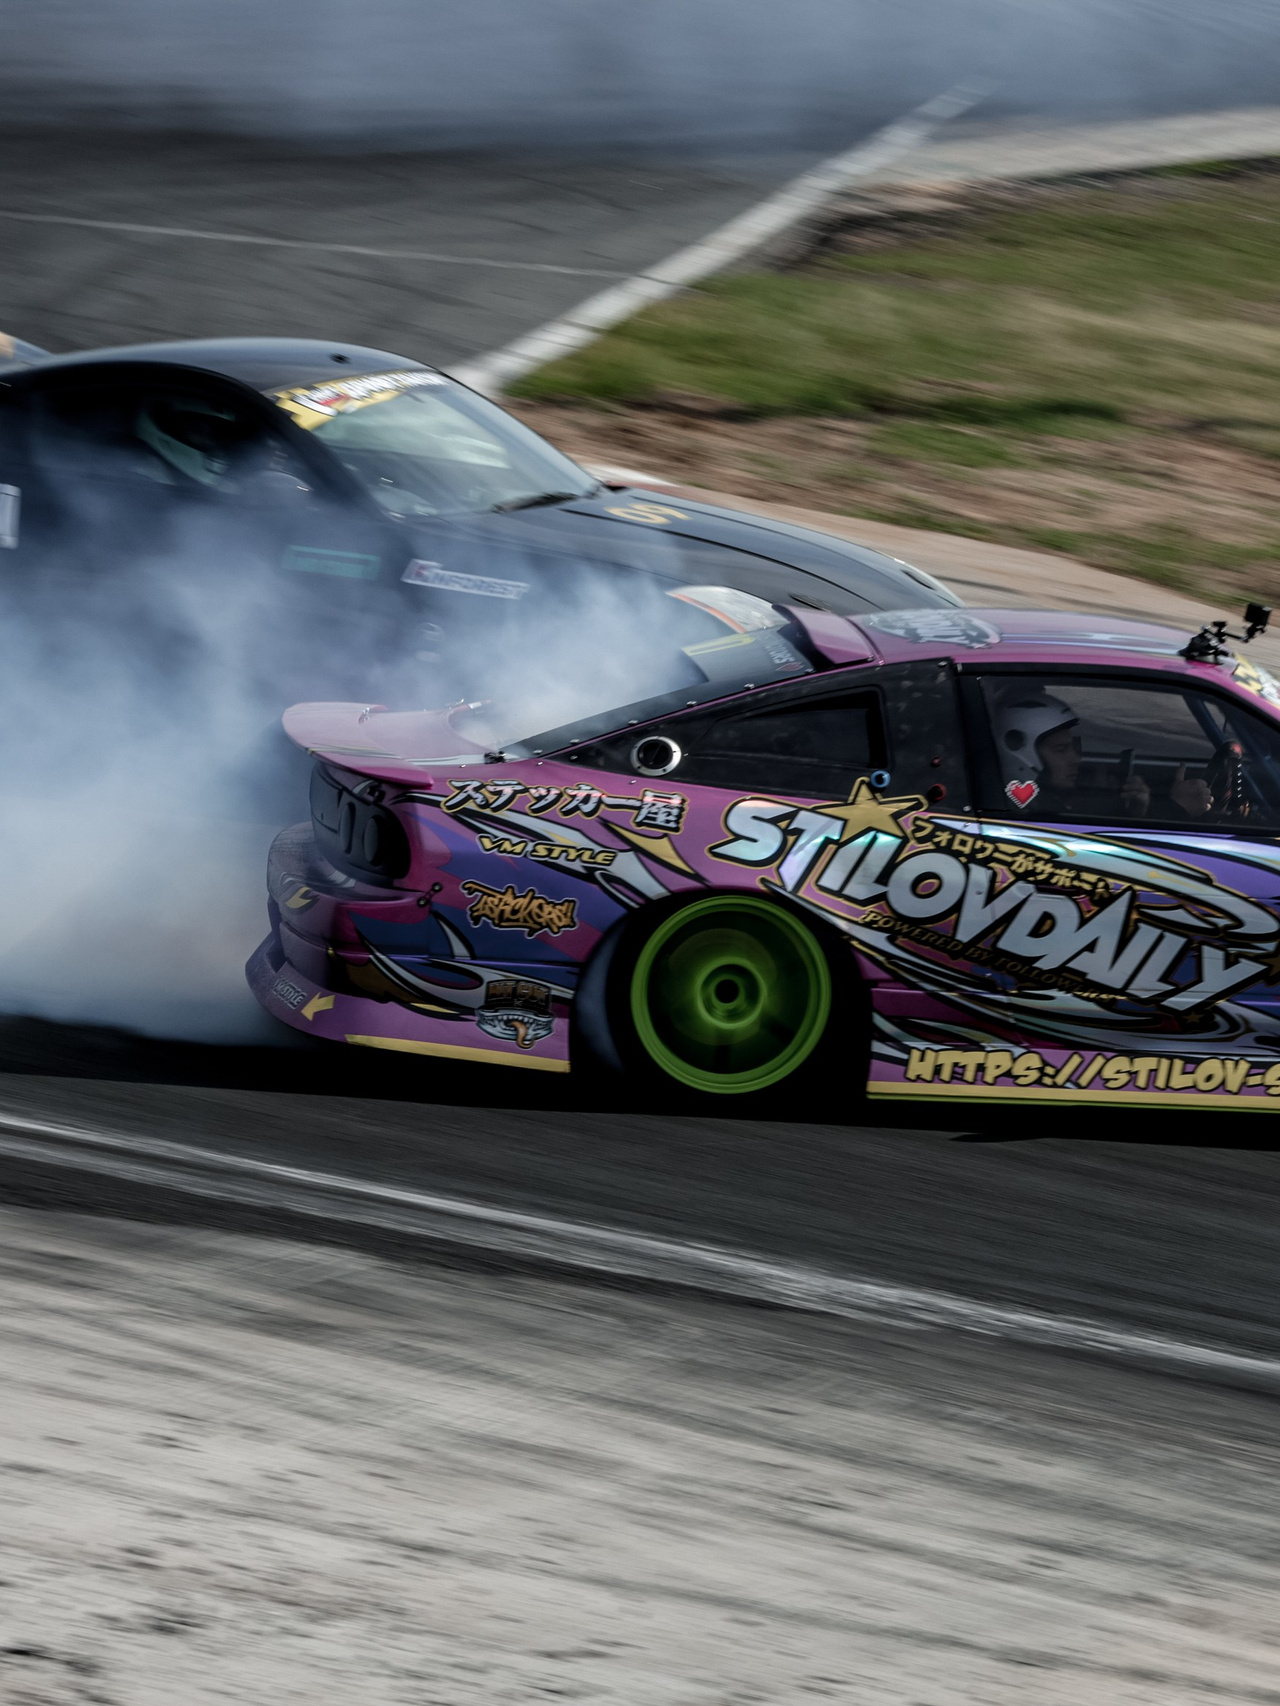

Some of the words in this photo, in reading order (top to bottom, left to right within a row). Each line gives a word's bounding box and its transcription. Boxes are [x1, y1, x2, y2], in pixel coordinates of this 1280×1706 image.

[445, 780, 685, 829] ステッカー屋
[480, 836, 525, 855] VM
[532, 843, 616, 865] STYLE
[866, 910, 962, 952] POWERED
[965, 945, 992, 961] BY
